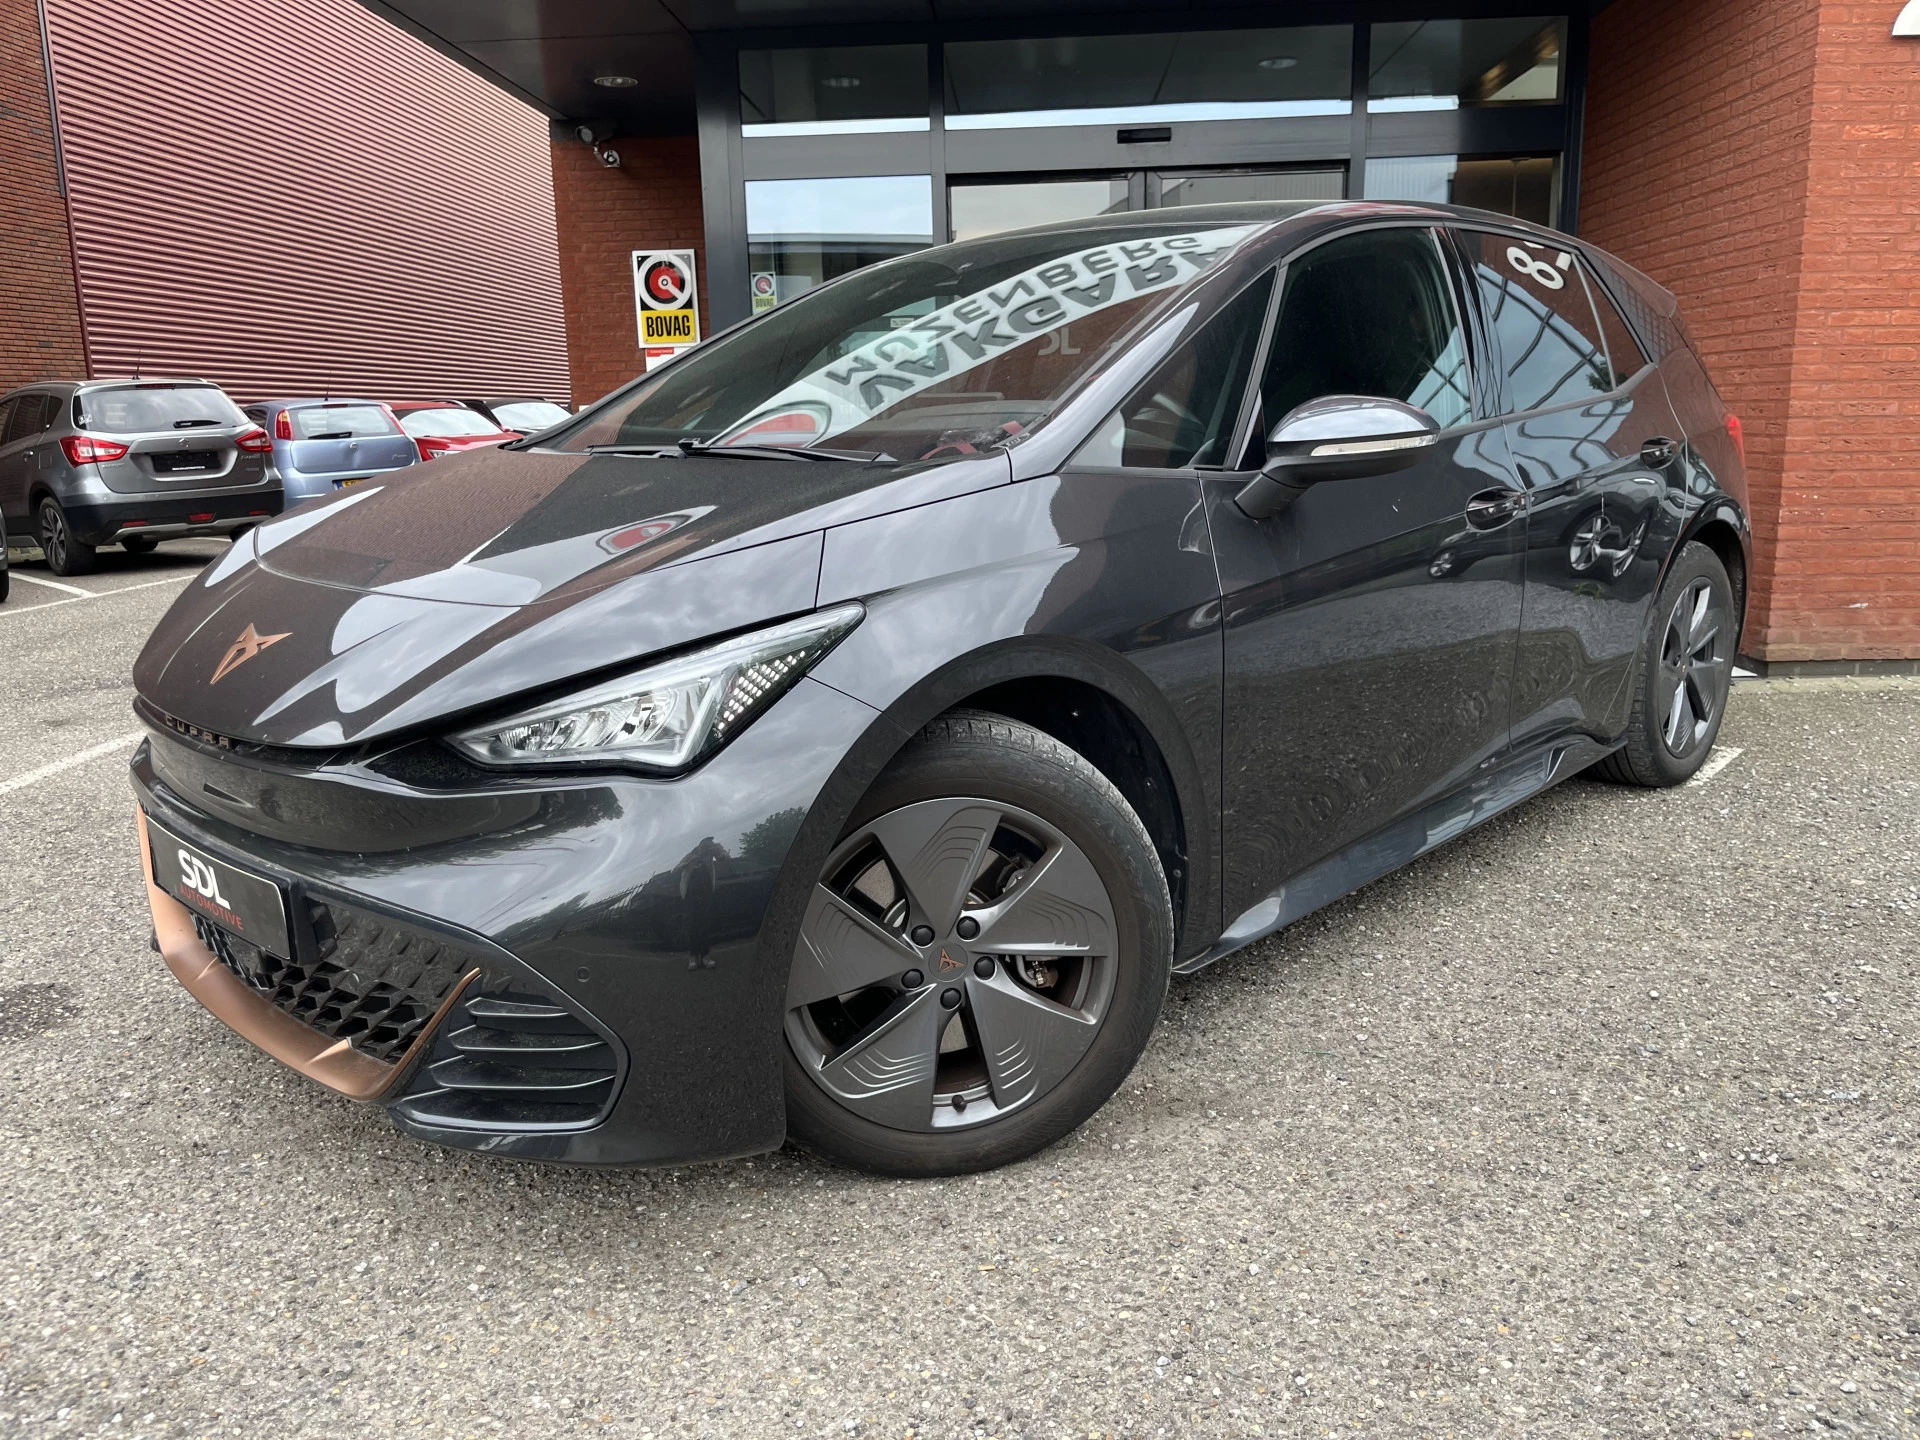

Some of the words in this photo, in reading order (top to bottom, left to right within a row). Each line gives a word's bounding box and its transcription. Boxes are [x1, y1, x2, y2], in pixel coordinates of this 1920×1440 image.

[755, 297, 775, 308] BOVAG
[646, 314, 691, 337] BOVAG
[165, 713, 229, 749] CUPRA
[178, 848, 231, 910] SDL
[180, 882, 244, 931] AUTOMOTIVE
